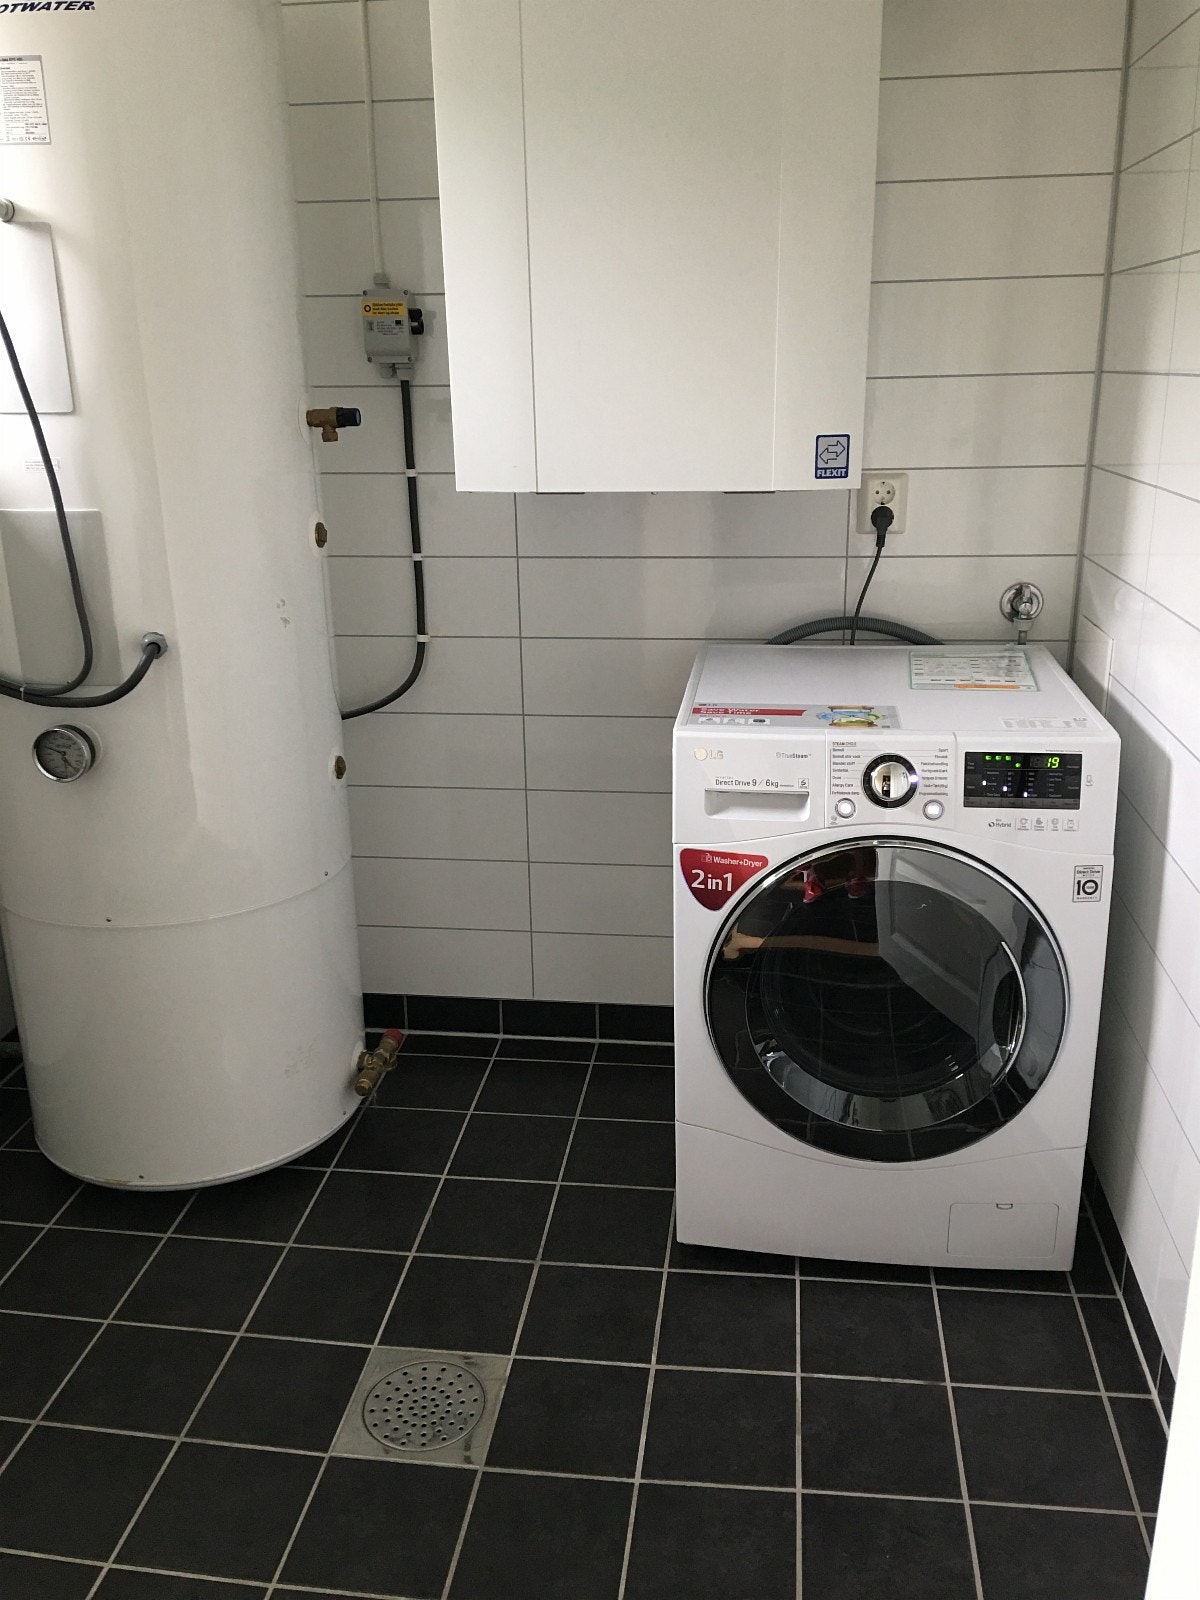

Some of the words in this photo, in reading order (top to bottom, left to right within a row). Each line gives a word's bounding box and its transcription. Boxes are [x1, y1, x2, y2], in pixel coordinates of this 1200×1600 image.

[817, 468, 847, 477] FLEXIT
[709, 749, 724, 759] LG
[734, 779, 751, 787] Drive
[765, 779, 779, 789] 6kg
[713, 855, 763, 868] Washer+Dryer
[1076, 879, 1099, 896] 10
